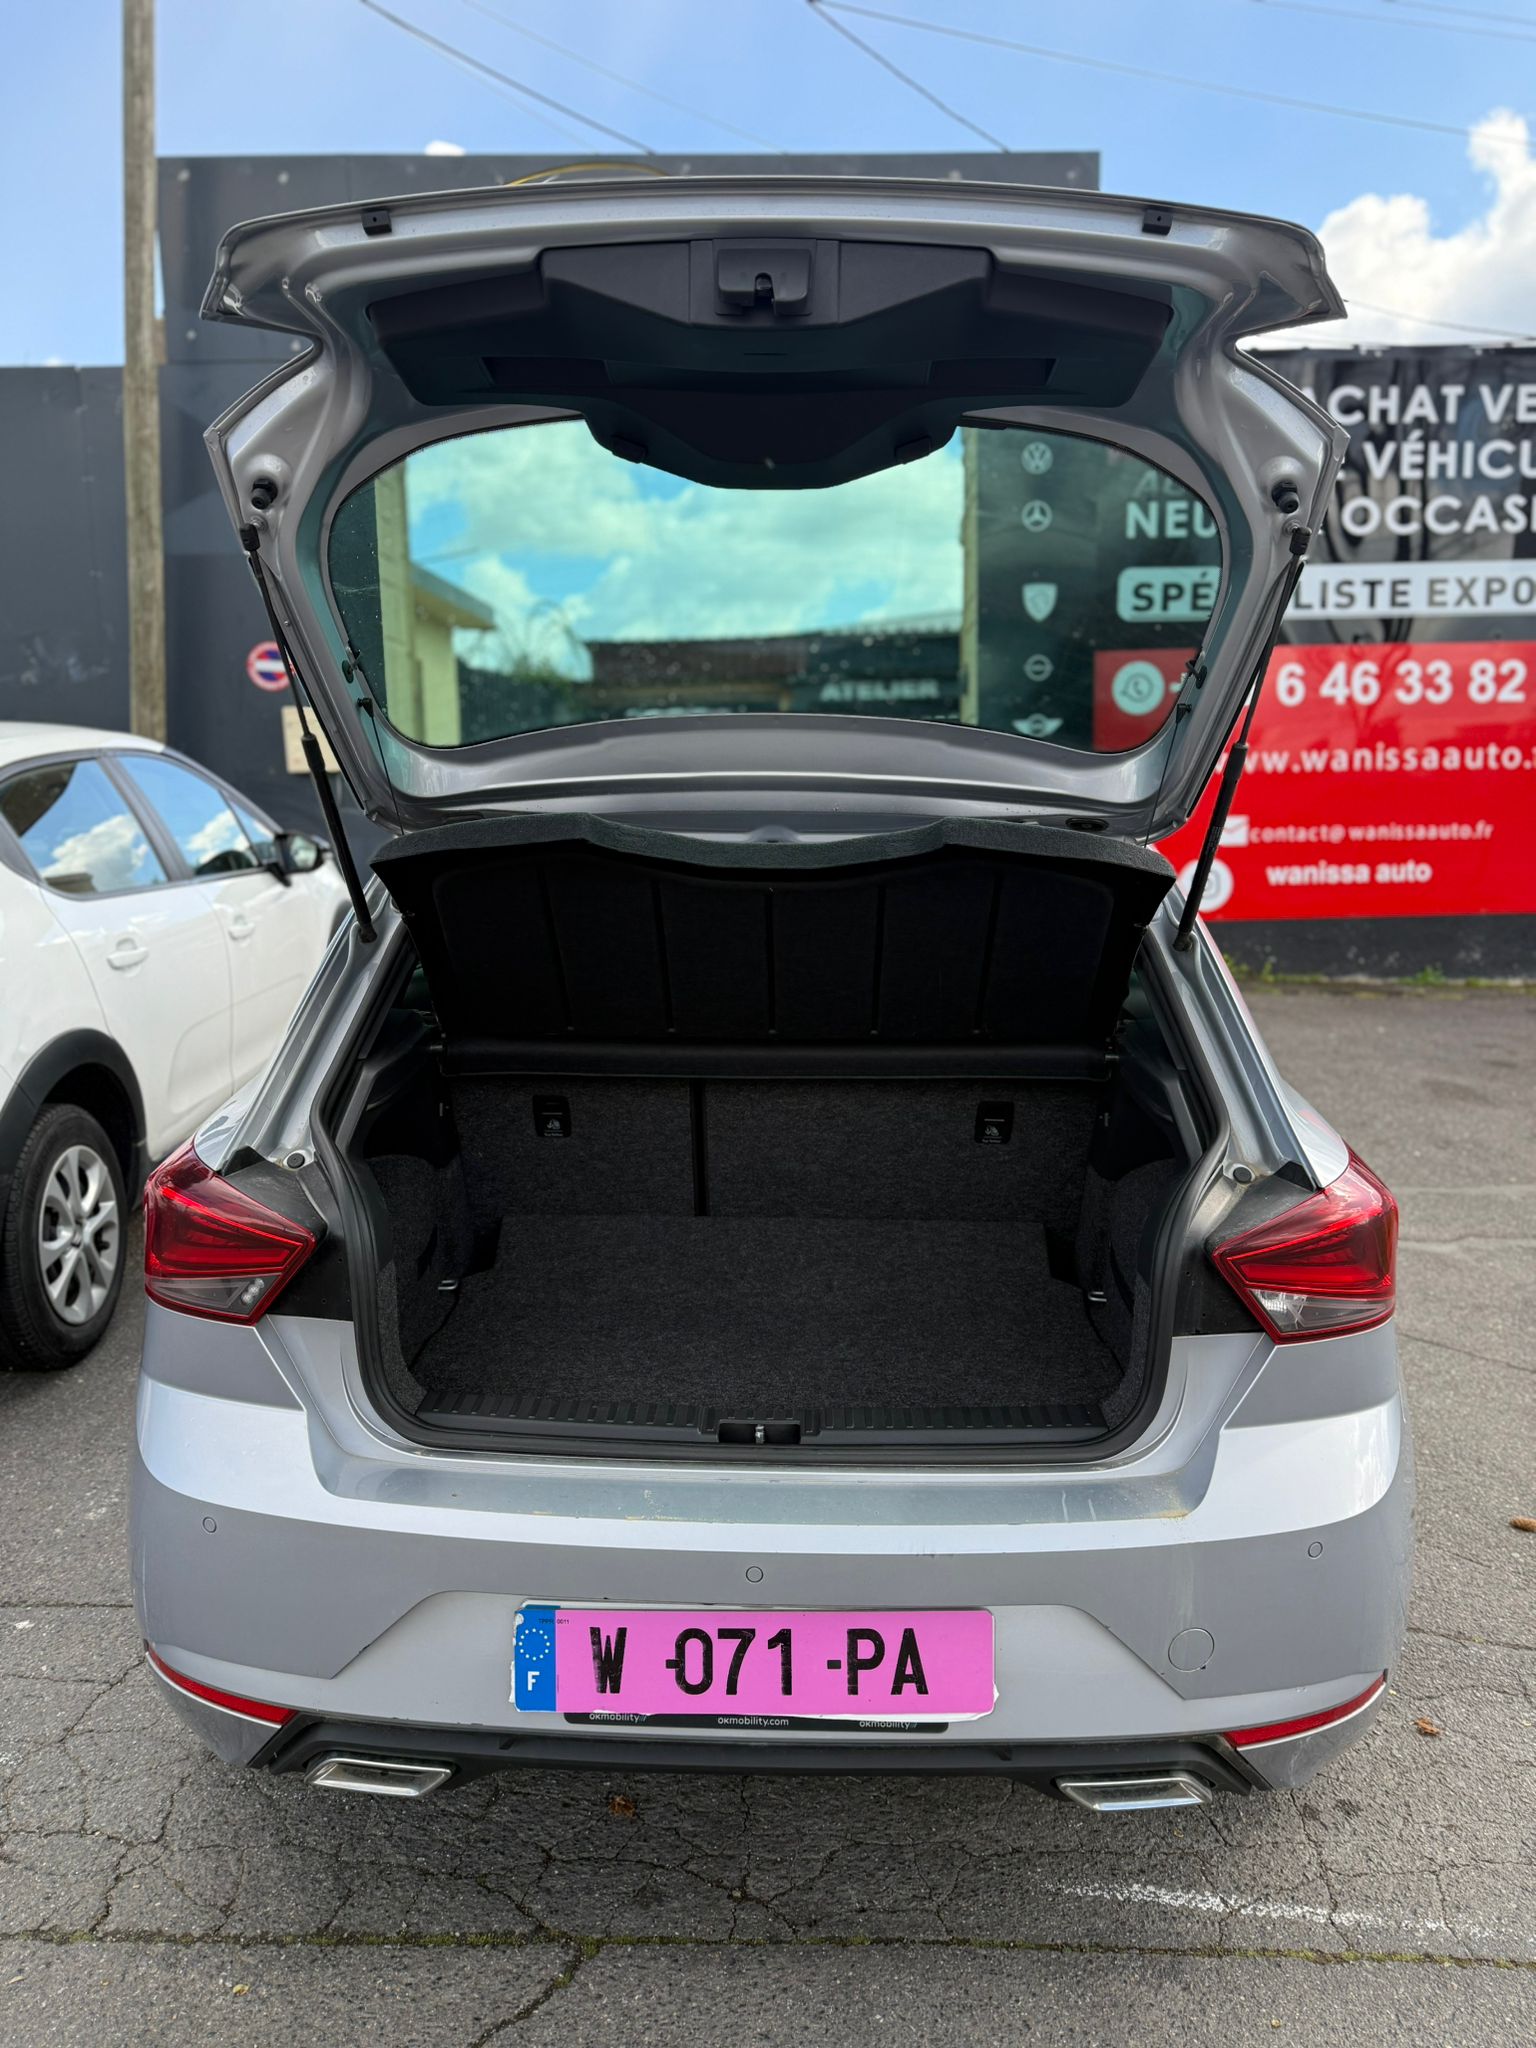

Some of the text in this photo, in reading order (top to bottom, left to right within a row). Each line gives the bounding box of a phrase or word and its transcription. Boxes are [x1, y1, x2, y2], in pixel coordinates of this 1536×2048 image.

[1479, 383, 1536, 424] VE
[1427, 576, 1536, 609] EXPO
[1276, 662, 1306, 707] 6
[1319, 661, 1380, 705] 46
[1395, 660, 1452, 704] 33
[1468, 658, 1528, 704] 82
[1265, 859, 1433, 886] wanissa auto
[527, 1671, 540, 1691] F
[717, 1716, 789, 1727] okmobility.com
